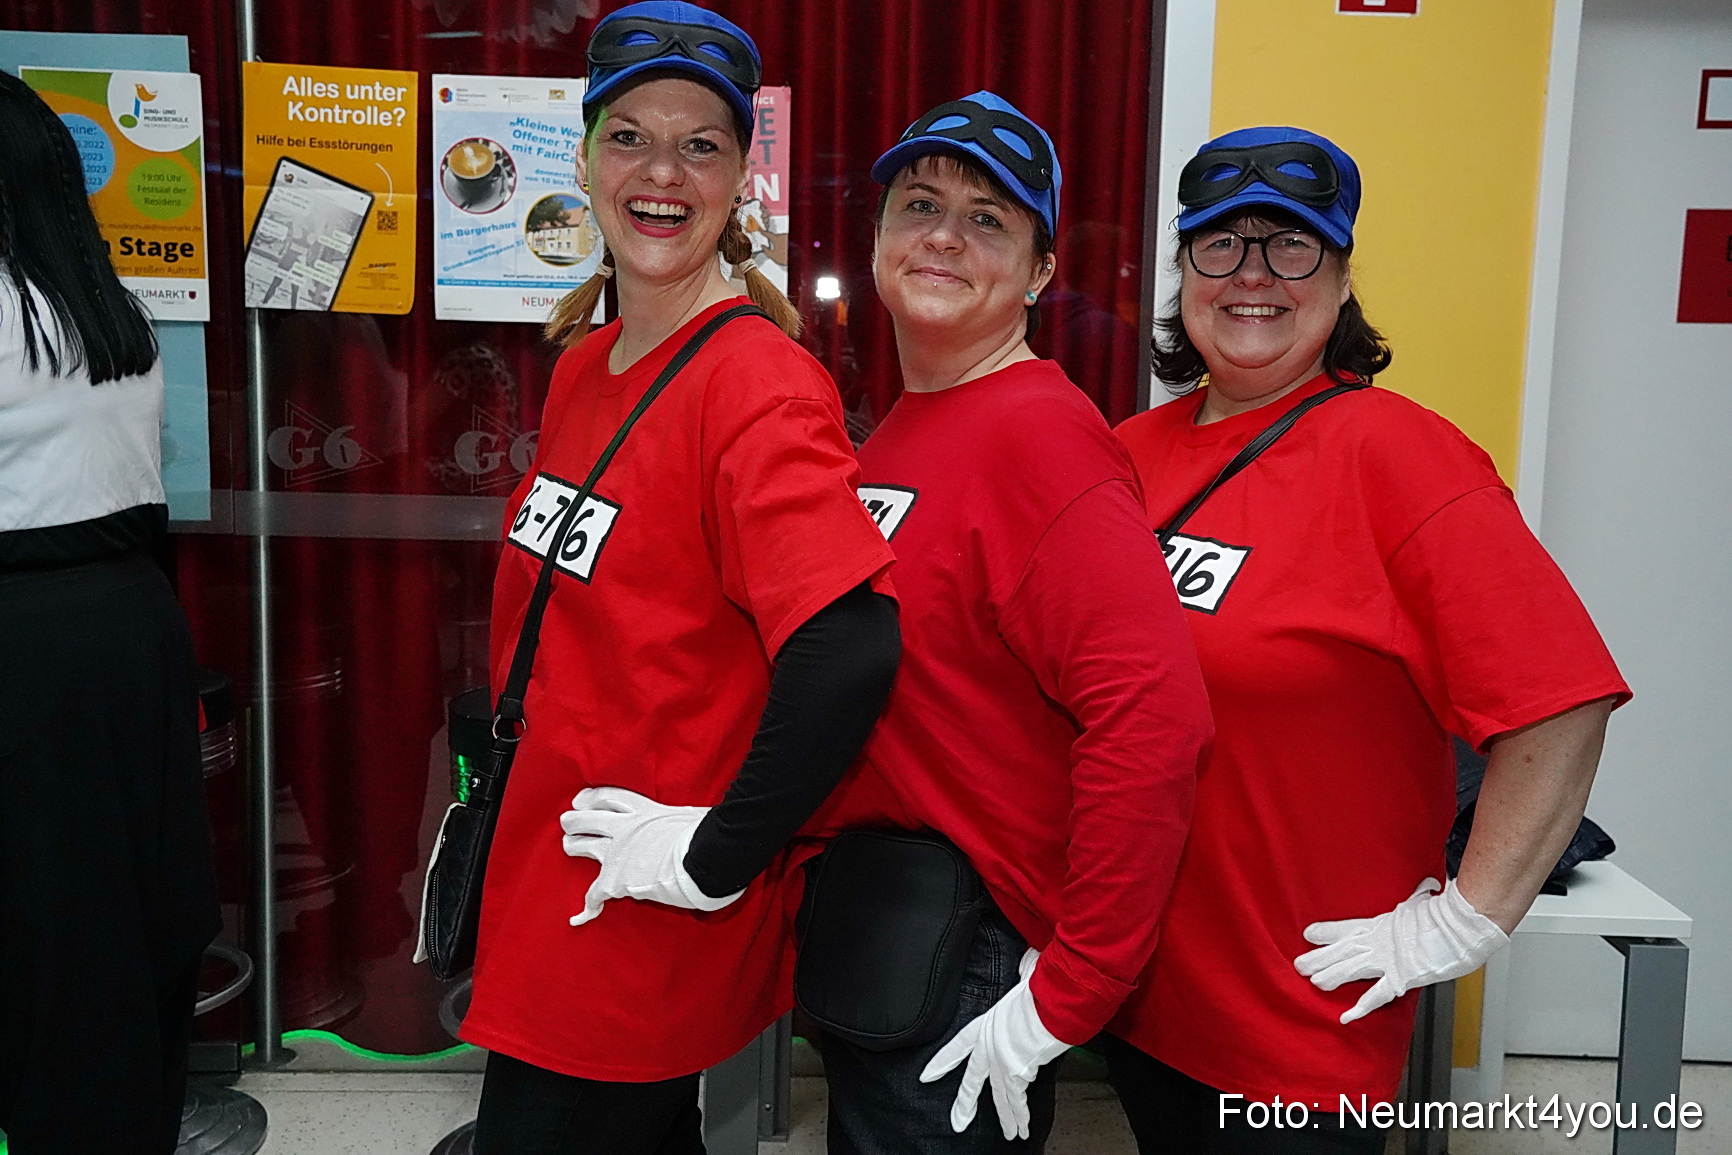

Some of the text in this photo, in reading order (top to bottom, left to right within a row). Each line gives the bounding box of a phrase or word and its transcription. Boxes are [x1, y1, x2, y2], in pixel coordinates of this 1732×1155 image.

[282, 75, 408, 102] Alles unter
[287, 101, 407, 127] Kontrolle?
[256, 134, 394, 154] Hilfe bei Essstörungen
[512, 129, 577, 151] Offener Tr
[511, 143, 577, 164] mit FairCa
[166, 174, 182, 183] Uhr
[535, 168, 577, 179] donnersta
[137, 185, 187, 195] Festsaal der
[144, 197, 182, 206] Residenz
[440, 220, 518, 240] im Bürgerhaus
[119, 236, 194, 263] Stage
[131, 288, 186, 299] EUMARKT
[522, 296, 560, 307] NEUM
